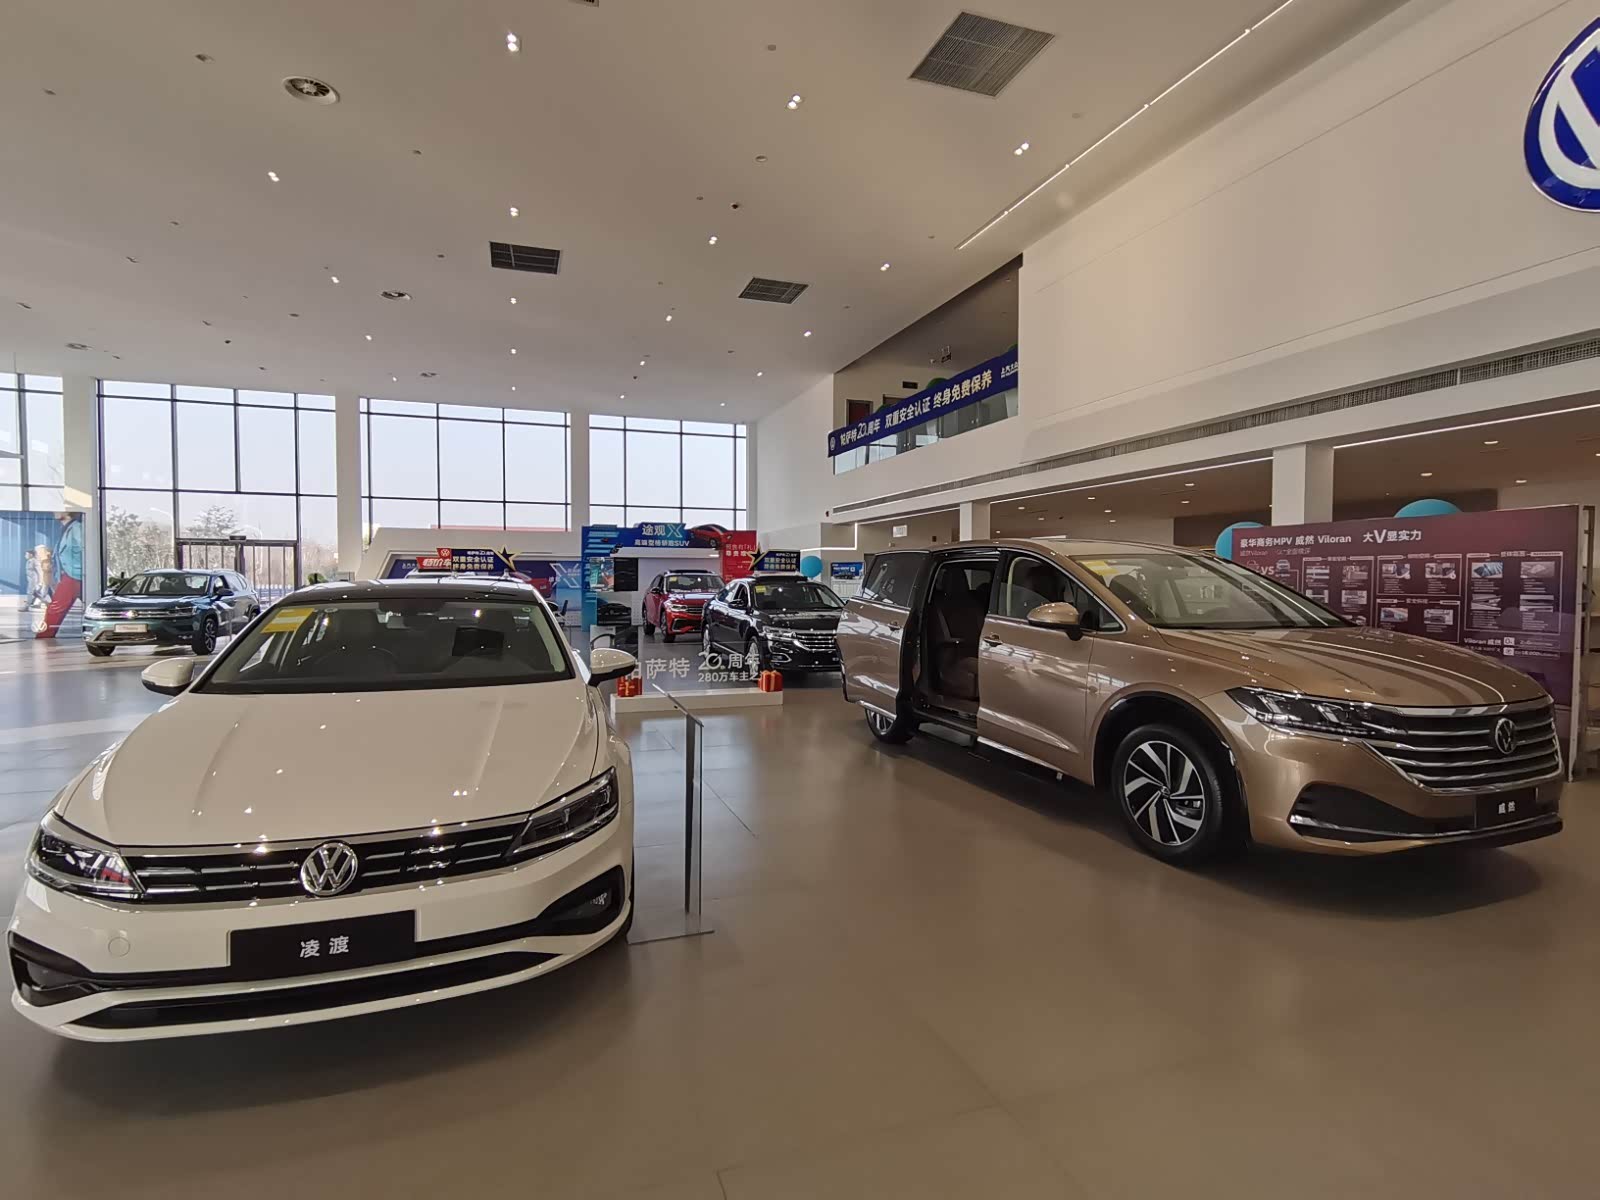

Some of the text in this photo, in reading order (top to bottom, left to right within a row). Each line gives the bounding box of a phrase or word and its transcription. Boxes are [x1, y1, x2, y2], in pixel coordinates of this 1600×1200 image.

[884, 396, 931, 429] 双重安全认证
[932, 368, 993, 408] 终身免费保养
[1239, 528, 1422, 548] 豪华商务MPV 威然 Viloran 大V显实力
[698, 671, 763, 683] 280万车主之
